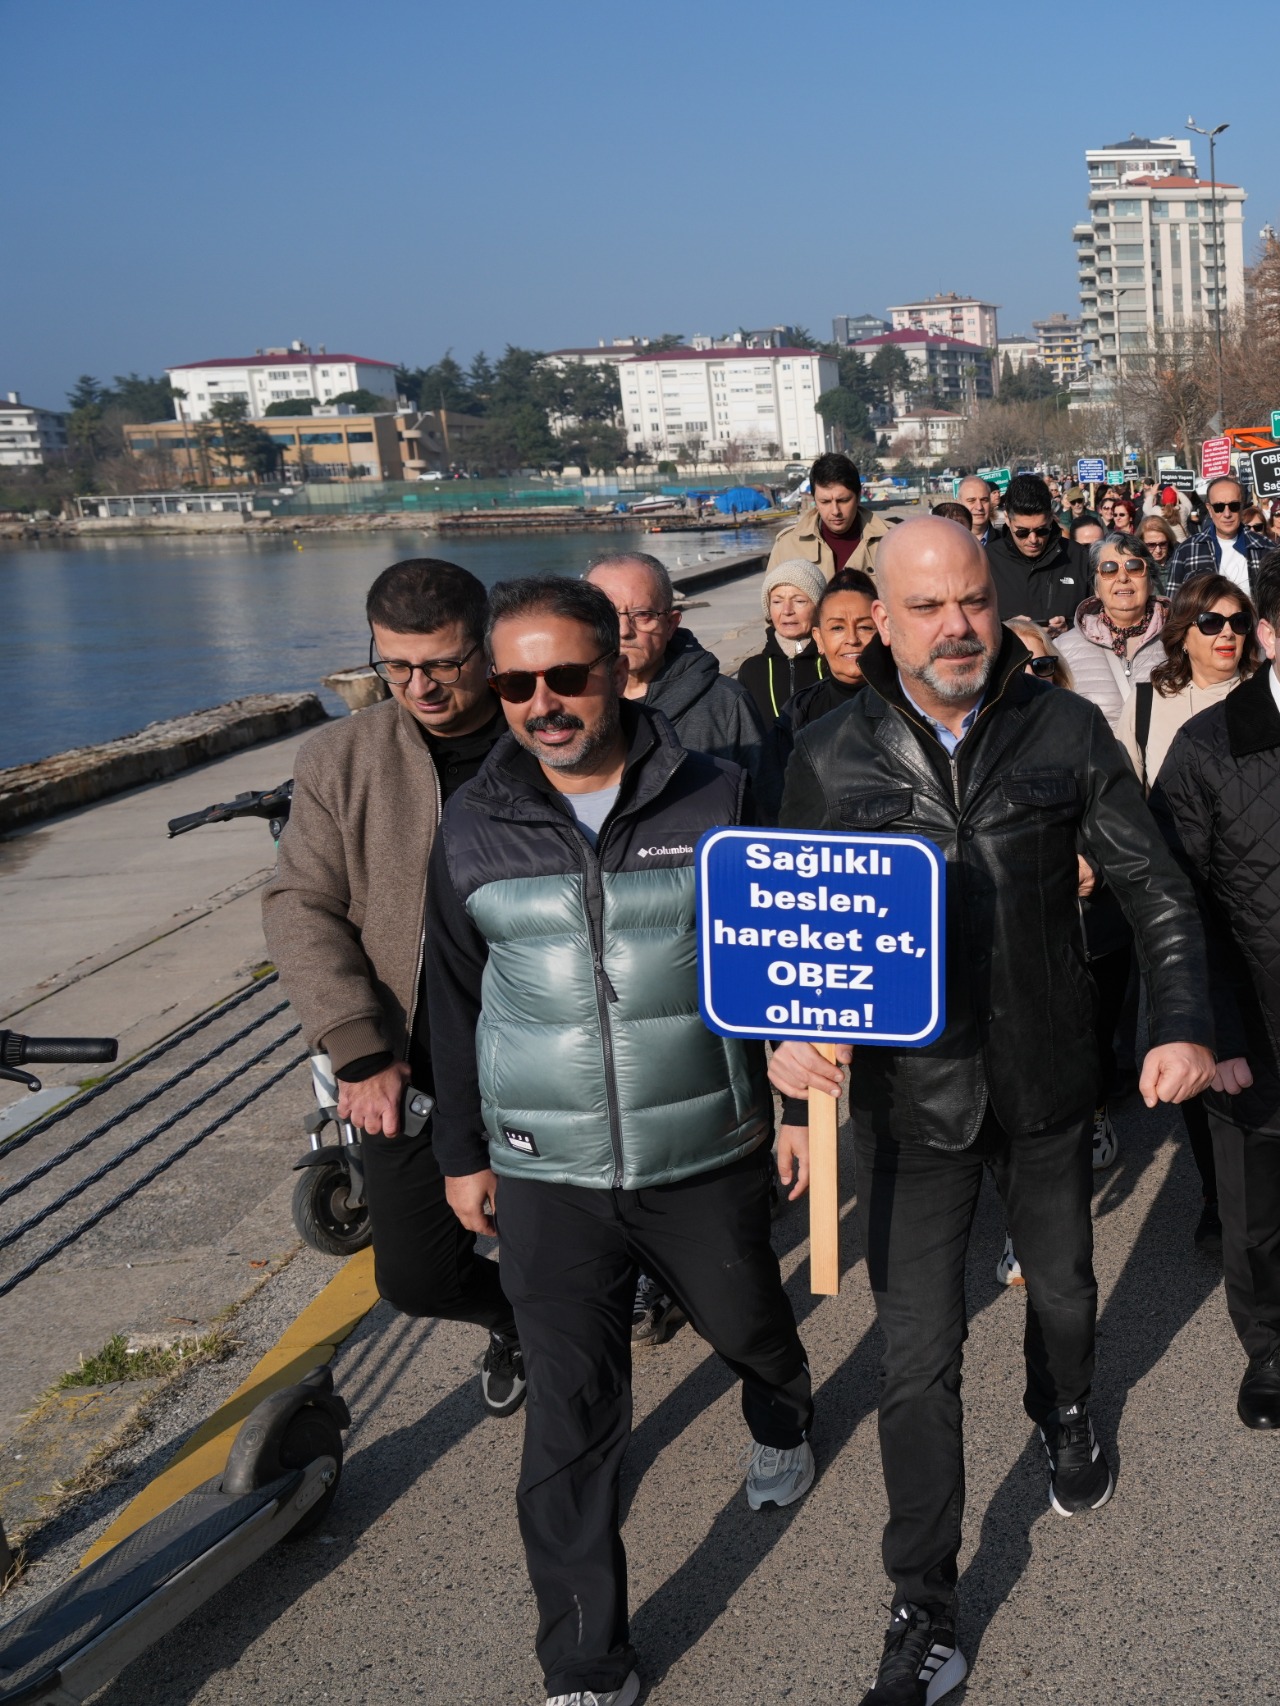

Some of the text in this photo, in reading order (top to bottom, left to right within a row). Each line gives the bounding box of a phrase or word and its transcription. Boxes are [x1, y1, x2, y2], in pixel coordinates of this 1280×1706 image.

[648, 845, 693, 855] Columbia
[746, 843, 890, 878] Sağlıklı
[750, 883, 888, 918] beslen,
[714, 919, 926, 958] hareket et,
[767, 960, 874, 990] OBEZ
[766, 1000, 873, 1028] olma!
